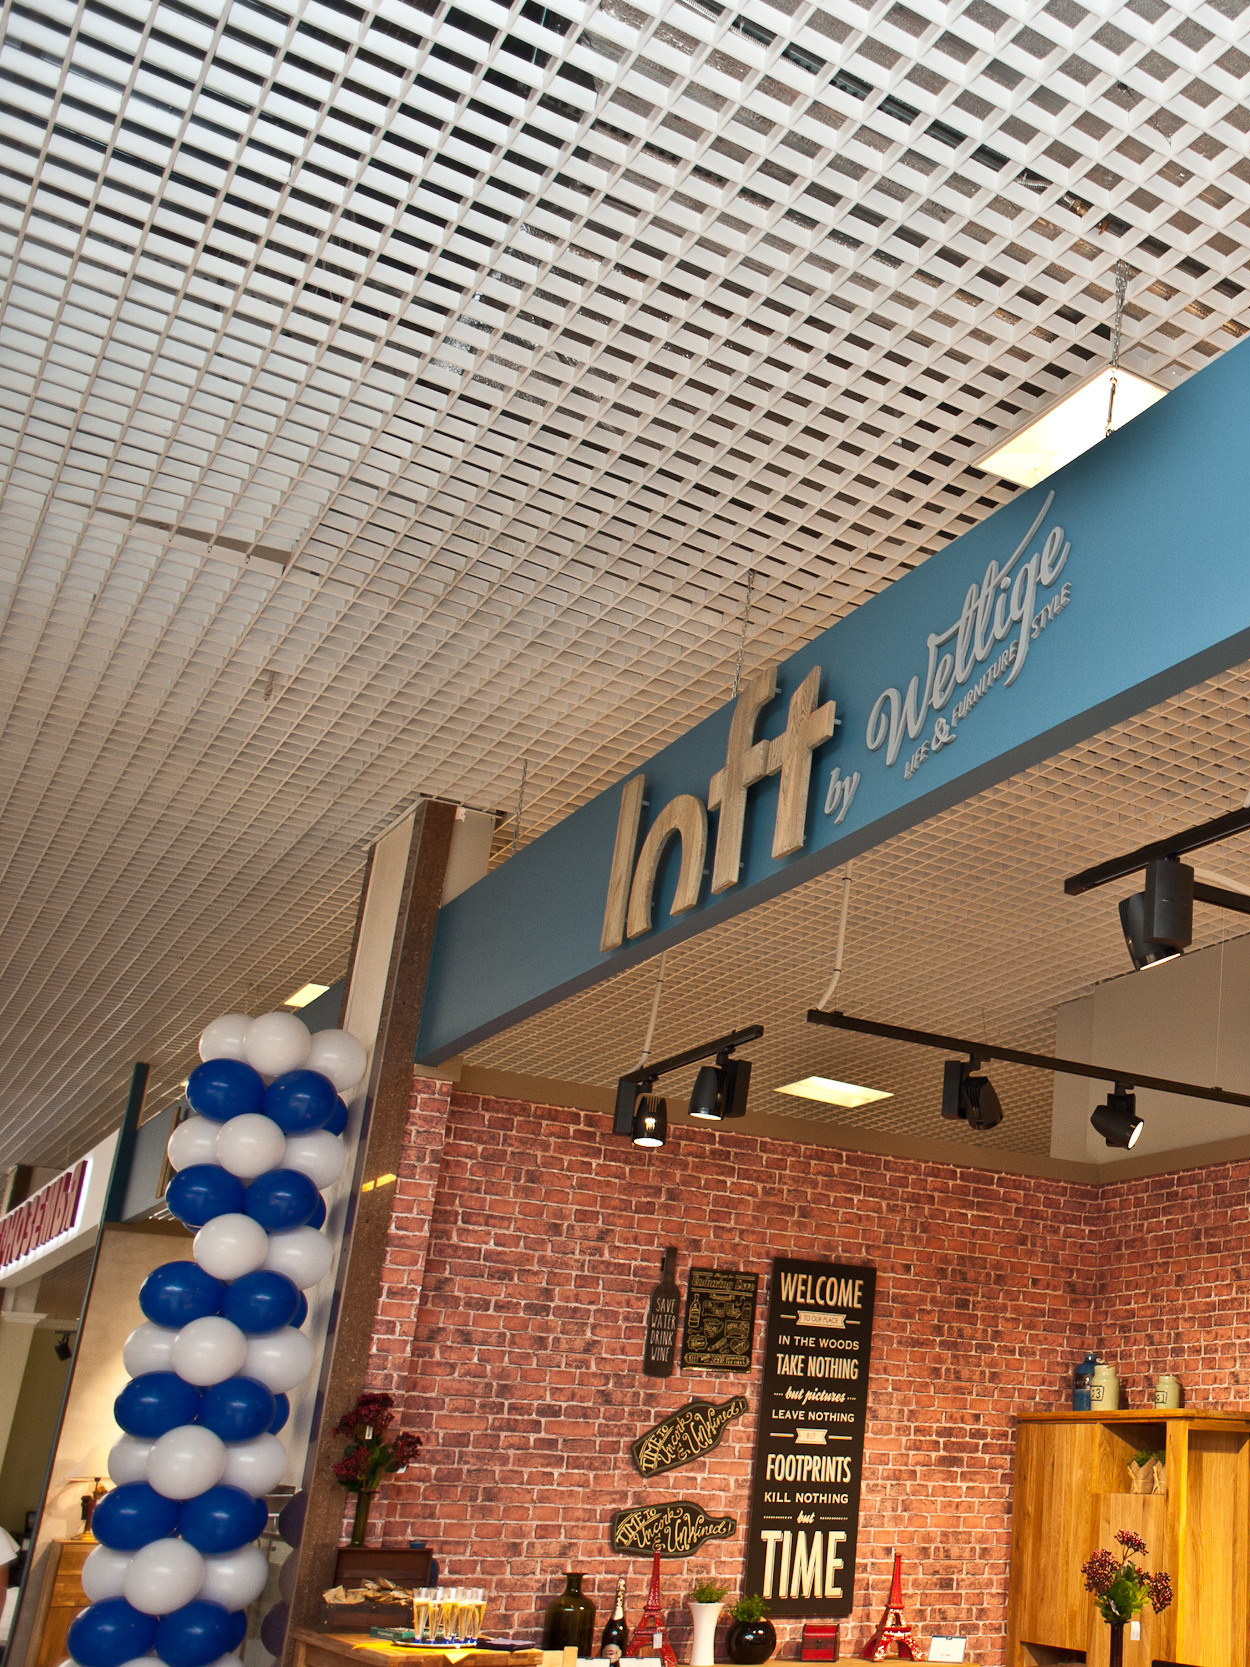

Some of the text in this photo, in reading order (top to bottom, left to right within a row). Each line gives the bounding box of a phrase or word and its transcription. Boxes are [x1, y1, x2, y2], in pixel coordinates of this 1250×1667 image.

[904, 582, 1071, 780] LIFE & FURNITURE STYLE
[824, 767, 861, 825] by
[780, 1272, 864, 1309] WELCOME
[656, 1298, 675, 1313] SAVE
[651, 1314, 676, 1329] WATER
[650, 1330, 674, 1345] DRINK
[778, 1334, 860, 1350] IN THE WOODS
[651, 1346, 670, 1361] WINE
[776, 1353, 805, 1377] TAKE
[807, 1355, 859, 1380] NOTHING
[785, 1386, 845, 1405] but pictures
[772, 1409, 855, 1423] LEAVE NOTHING
[806, 1432, 816, 1440] BUT
[642, 1425, 669, 1471] TIME TO
[766, 1453, 852, 1484] FOOTPRINTS
[764, 1491, 849, 1504] KILL NOTHING
[797, 1510, 815, 1524] but
[615, 1508, 657, 1546] TIME TO
[761, 1530, 847, 1600] TIME
